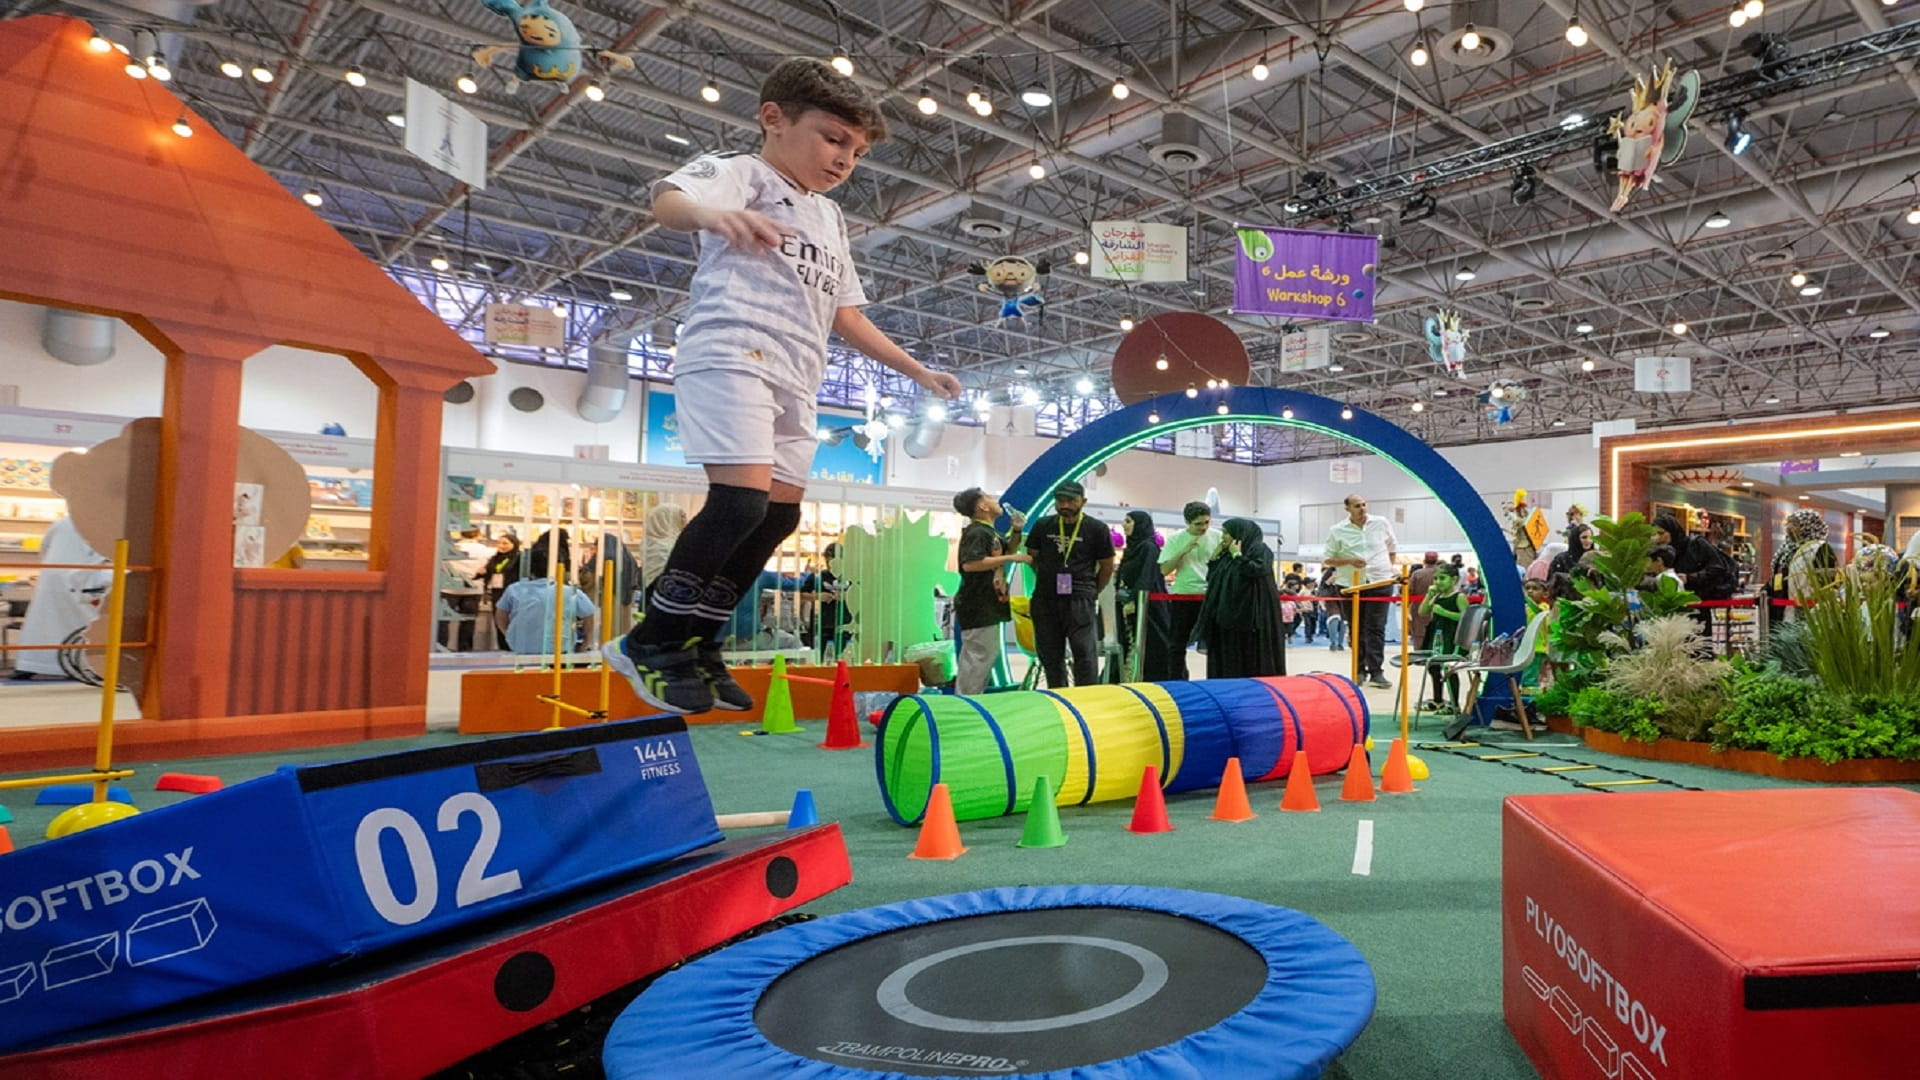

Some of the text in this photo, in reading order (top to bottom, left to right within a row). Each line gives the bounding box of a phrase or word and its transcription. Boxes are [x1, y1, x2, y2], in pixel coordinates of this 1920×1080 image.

[1274, 264, 1307, 281] عمل
[1310, 264, 1350, 286] ورشة
[1266, 288, 1347, 307] Workshop 6
[633, 740, 677, 763] 1441
[641, 762, 681, 780] FITNESS
[355, 791, 523, 926] 02
[0, 846, 201, 934] OFTBOX
[1526, 895, 1668, 1067] PLYOSOFTBOX
